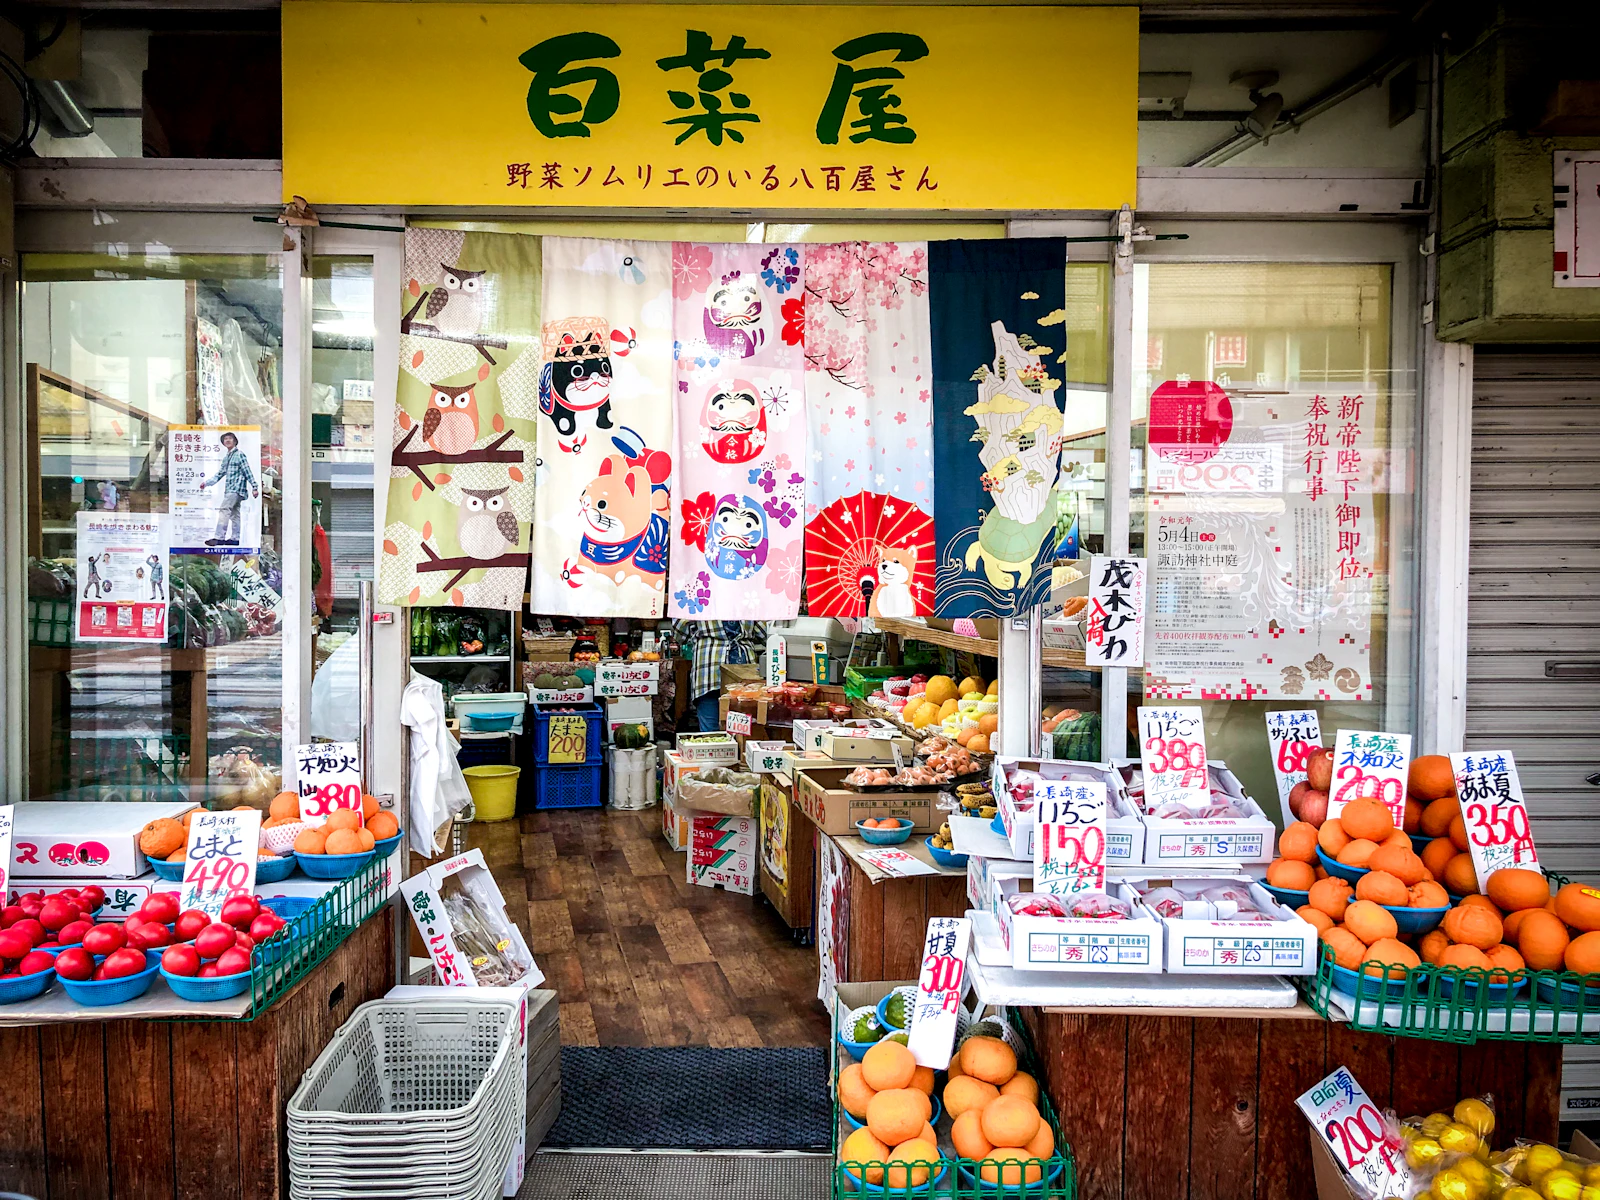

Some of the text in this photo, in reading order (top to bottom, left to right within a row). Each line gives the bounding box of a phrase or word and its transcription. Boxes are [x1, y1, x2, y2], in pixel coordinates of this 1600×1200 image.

[518, 29, 930, 146] 百菜屋
[505, 162, 938, 192] 野菜ソムリエのいる八百屋さん
[174, 444, 221, 452] 歩きまわる
[174, 454, 193, 462] 魅力
[725, 435, 739, 460] 合格
[1301, 394, 1331, 502] 奉祝行事
[1335, 394, 1364, 582] 新帝陛下御即位
[1159, 514, 1193, 525] 令和元年
[1158, 525, 1199, 543] 5月4日
[724, 551, 736, 574] 必勝
[1157, 553, 1238, 567] 諏訪神社中庭
[1086, 559, 1137, 661] 茂木びわ 入荷
[1147, 719, 1200, 740] いちご
[1270, 727, 1319, 743] サンふじ
[550, 735, 585, 754] 200
[1145, 737, 1207, 774] 380
[1346, 733, 1403, 755] 長崎産
[299, 756, 360, 775] 不知火
[762, 756, 783, 770] 電子
[1339, 751, 1404, 770] 不知火
[1332, 765, 1404, 806] 200
[1460, 773, 1520, 807] あま夏
[305, 783, 361, 817] 380
[1038, 800, 1104, 825] いちご
[1466, 803, 1531, 847] 350
[189, 834, 242, 860] とまと
[1042, 823, 1105, 868] 150
[1190, 844, 1207, 856] 秀
[185, 856, 250, 897] 490
[927, 931, 957, 961] 甘夏
[1065, 946, 1084, 960] 秀
[1220, 950, 1239, 964] 秀
[921, 955, 964, 993] 300
[942, 990, 961, 1015] 円
[1310, 1070, 1362, 1107] 日向夏
[1325, 1103, 1386, 1170] 200
